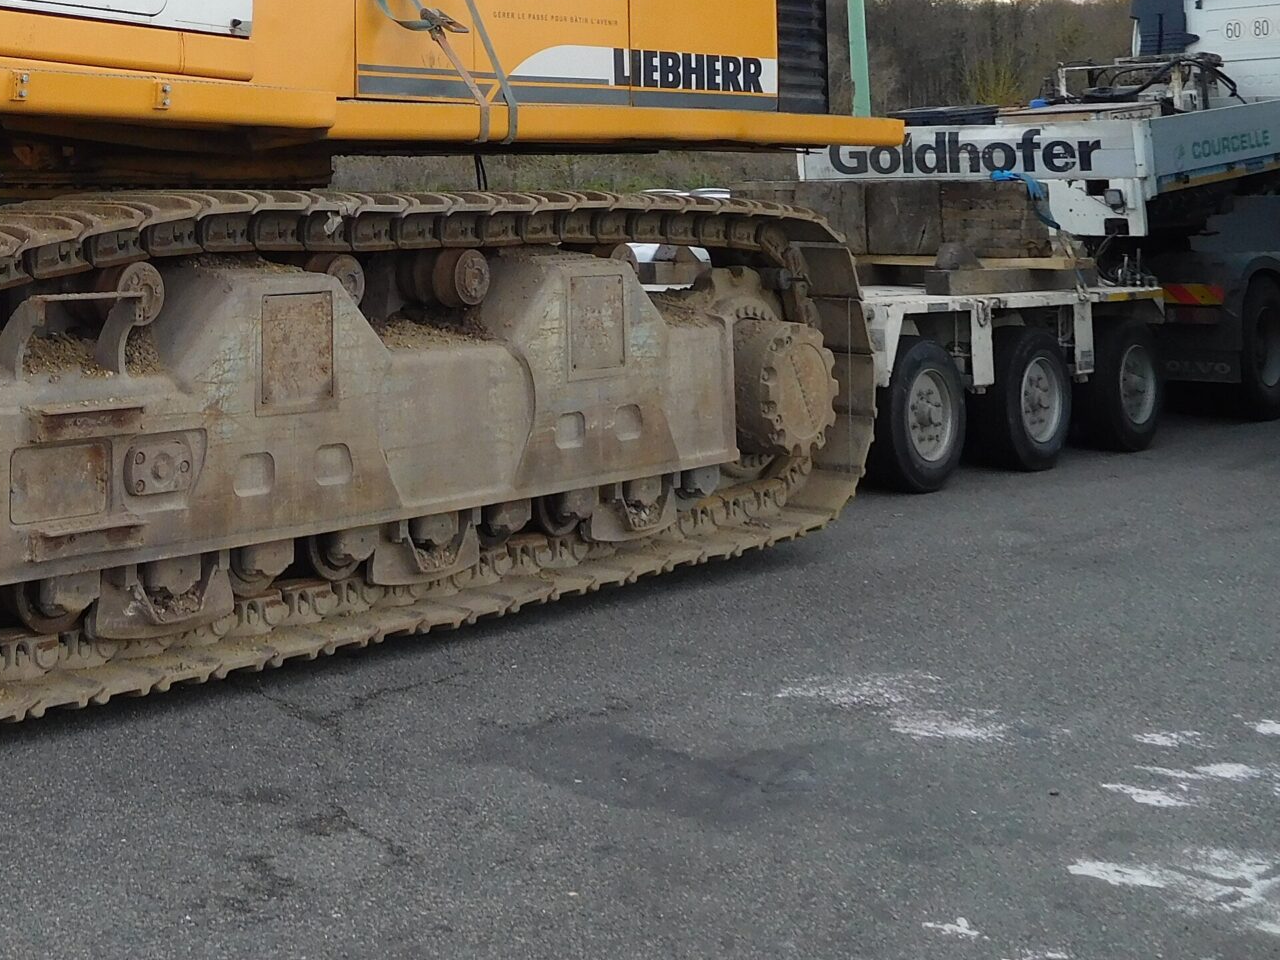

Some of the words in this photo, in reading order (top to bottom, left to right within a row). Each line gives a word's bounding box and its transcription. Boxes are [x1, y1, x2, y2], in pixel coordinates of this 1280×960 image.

[517, 12, 525, 20] LE
[551, 14, 568, 23] POUR
[1226, 22, 1241, 39] 60
[1253, 20, 1269, 37] 80
[613, 47, 763, 93] LIEBHERR
[829, 128, 1101, 174] Goldhofer
[1192, 129, 1271, 159] COURCELLE
